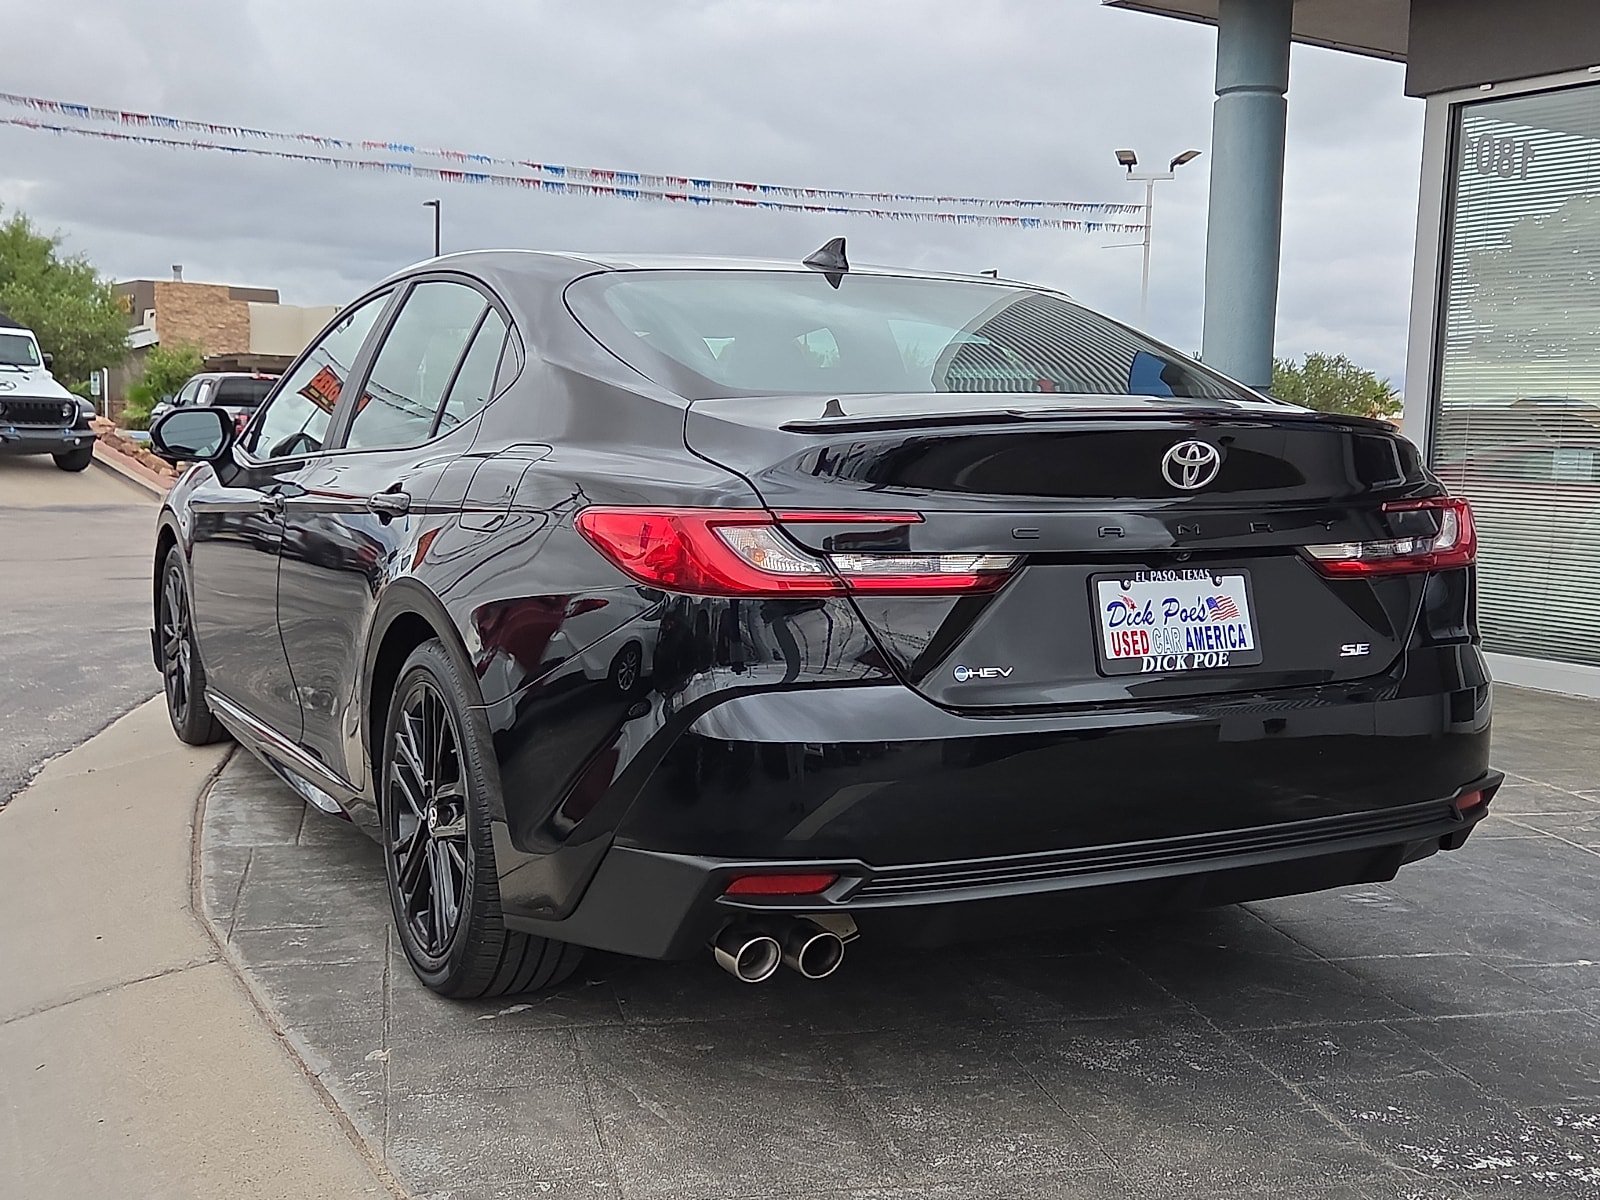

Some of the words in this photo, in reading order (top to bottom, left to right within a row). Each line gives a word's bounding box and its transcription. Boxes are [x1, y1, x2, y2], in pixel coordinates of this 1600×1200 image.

[1010, 519, 1336, 540] CAMRY
[1135, 571, 1147, 582] EL
[1150, 570, 1179, 582] PASO,
[1182, 568, 1211, 581] TEXAS
[1106, 599, 1156, 628] Dick
[1161, 596, 1209, 626] Poe's
[1110, 629, 1150, 657] USED
[1152, 627, 1183, 655] CAR
[1186, 624, 1247, 651] AMERICA
[1339, 643, 1371, 657] SE
[1140, 655, 1188, 673] DICK
[1191, 651, 1230, 669] POE
